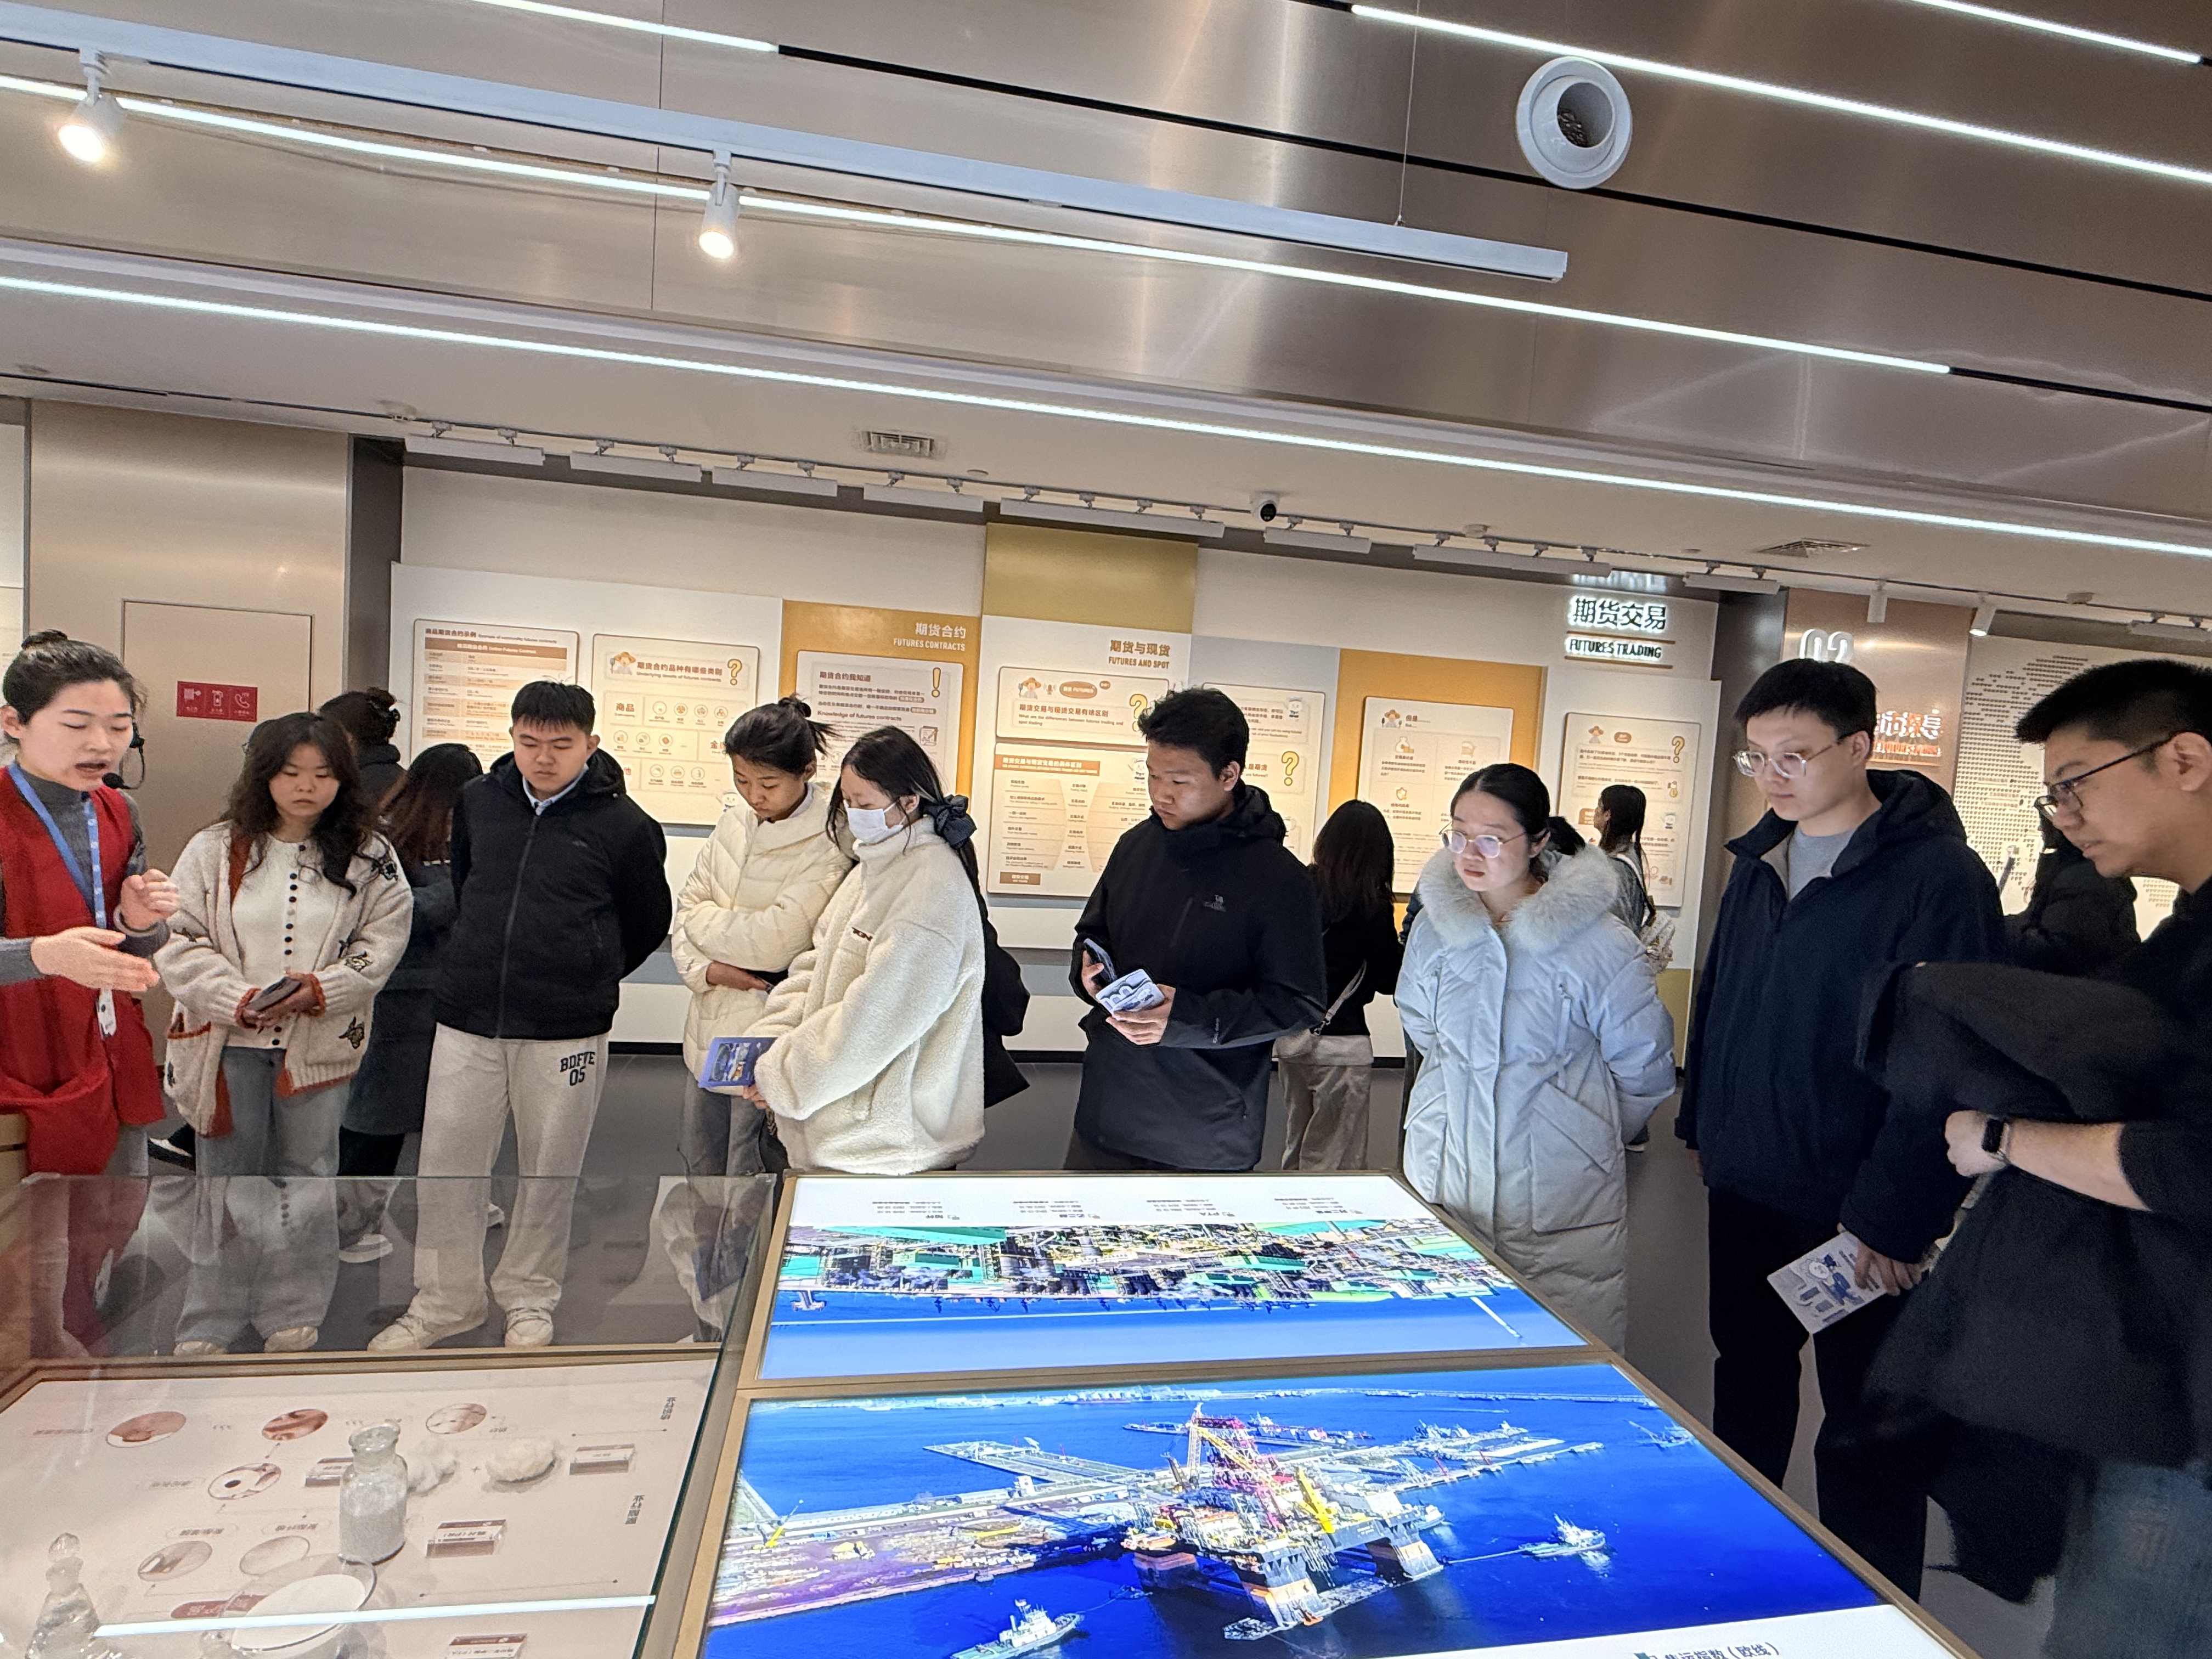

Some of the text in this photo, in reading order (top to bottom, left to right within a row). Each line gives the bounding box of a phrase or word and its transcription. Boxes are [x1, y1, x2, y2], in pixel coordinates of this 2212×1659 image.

[1572, 597, 1666, 630] 期货交易
[915, 623, 966, 639] 期货合约
[893, 637, 966, 652] FUTURES CONTRACTS
[1110, 640, 1170, 657] 期货与现货
[1570, 639, 1662, 658] FUTURES TRADING
[1108, 656, 1170, 669] FUTURES AND SPOT
[616, 703, 634, 712] 商品
[569, 1065, 586, 1086] 05
